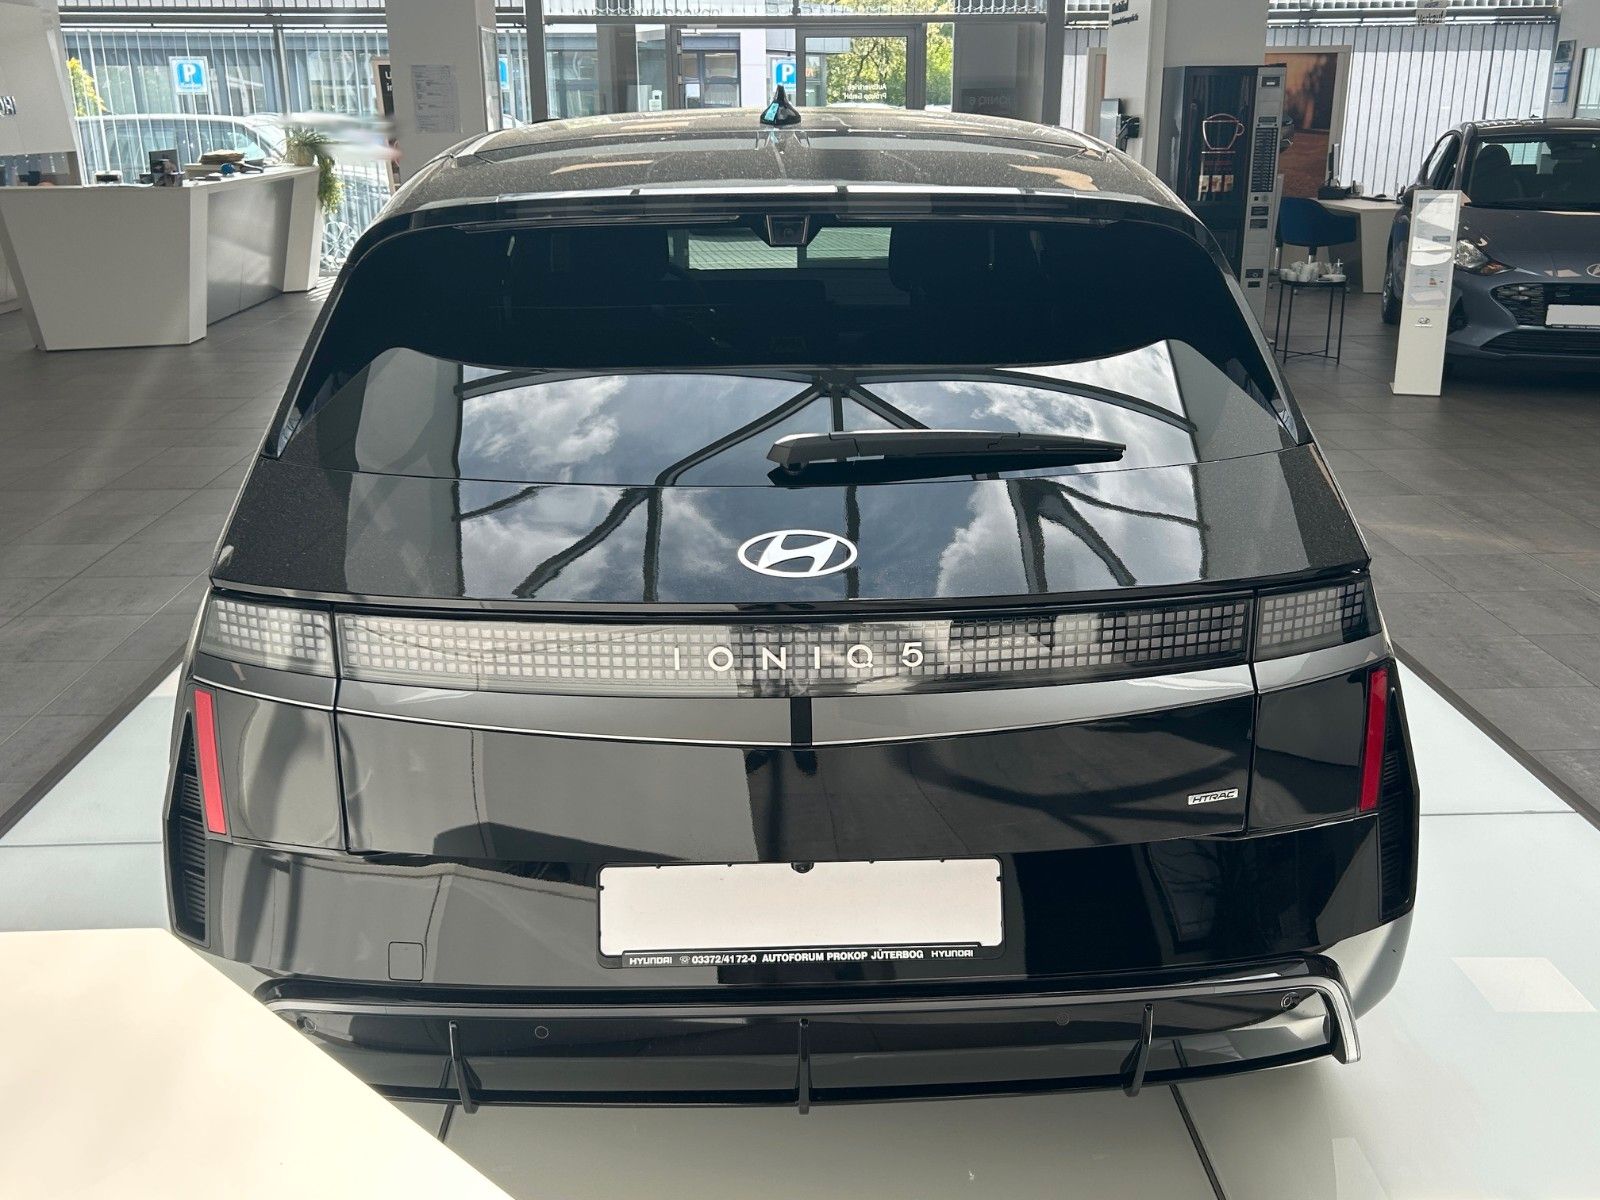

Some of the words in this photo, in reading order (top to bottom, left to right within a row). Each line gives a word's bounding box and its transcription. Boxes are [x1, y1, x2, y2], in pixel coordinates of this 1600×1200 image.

[183, 64, 196, 82] P
[782, 63, 795, 82] P
[673, 645, 874, 672] IONIQ
[901, 641, 924, 667] 5
[1192, 790, 1236, 803] HTRAC
[629, 957, 673, 965] HYUNDAI
[761, 952, 824, 962] AUTOFORUM
[826, 951, 868, 961] PROKOP
[870, 949, 923, 960] JÜTERBOG
[931, 949, 973, 958] HYUNDAI
